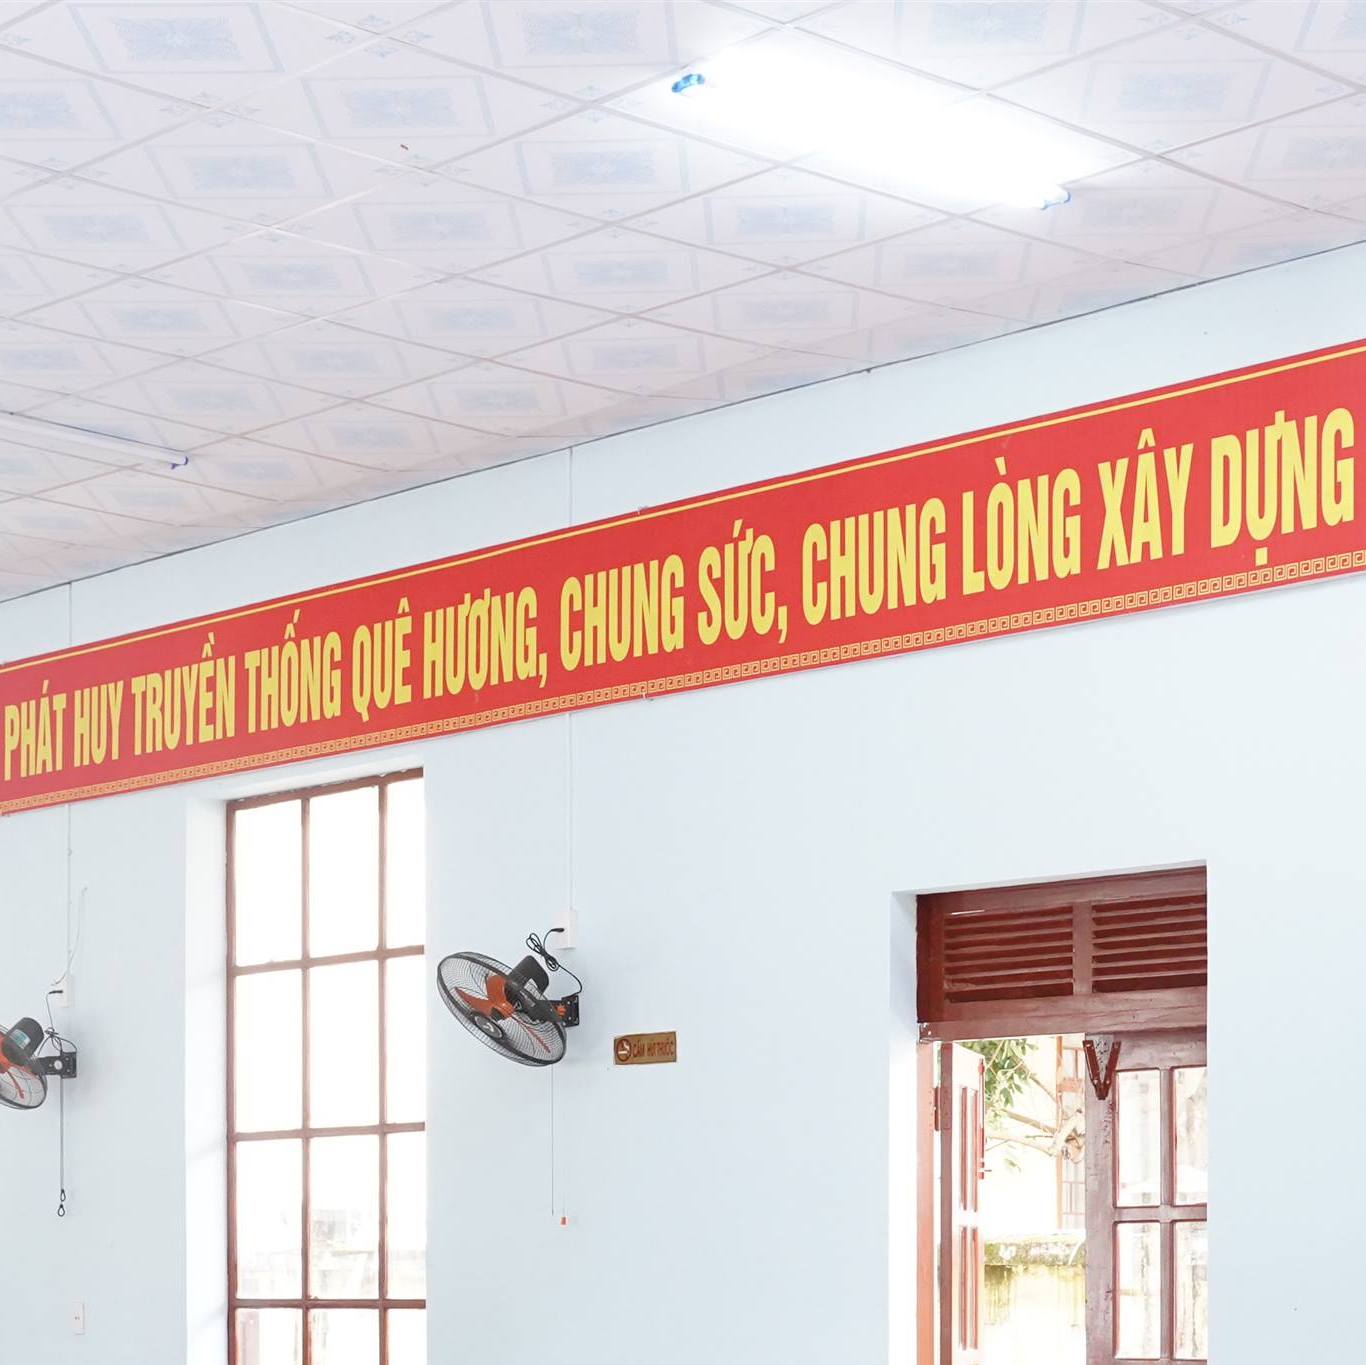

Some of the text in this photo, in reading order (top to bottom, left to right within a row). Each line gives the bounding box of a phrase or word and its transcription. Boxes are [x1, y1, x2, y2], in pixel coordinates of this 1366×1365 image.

[4, 680, 67, 780] PHÁT
[75, 681, 124, 767] HUY
[131, 632, 236, 755] TRUYỀN
[244, 603, 342, 733] THỐNG
[352, 605, 412, 722] QUÊ
[423, 586, 548, 699] HƯƠNG,
[560, 554, 684, 671] CHUNG
[697, 519, 787, 645] SỨC,
[802, 497, 946, 625] CHUNG
[962, 456, 1082, 595] LÒNG
[1097, 427, 1194, 570] XÂY
[1210, 408, 1355, 566] DỰNG
